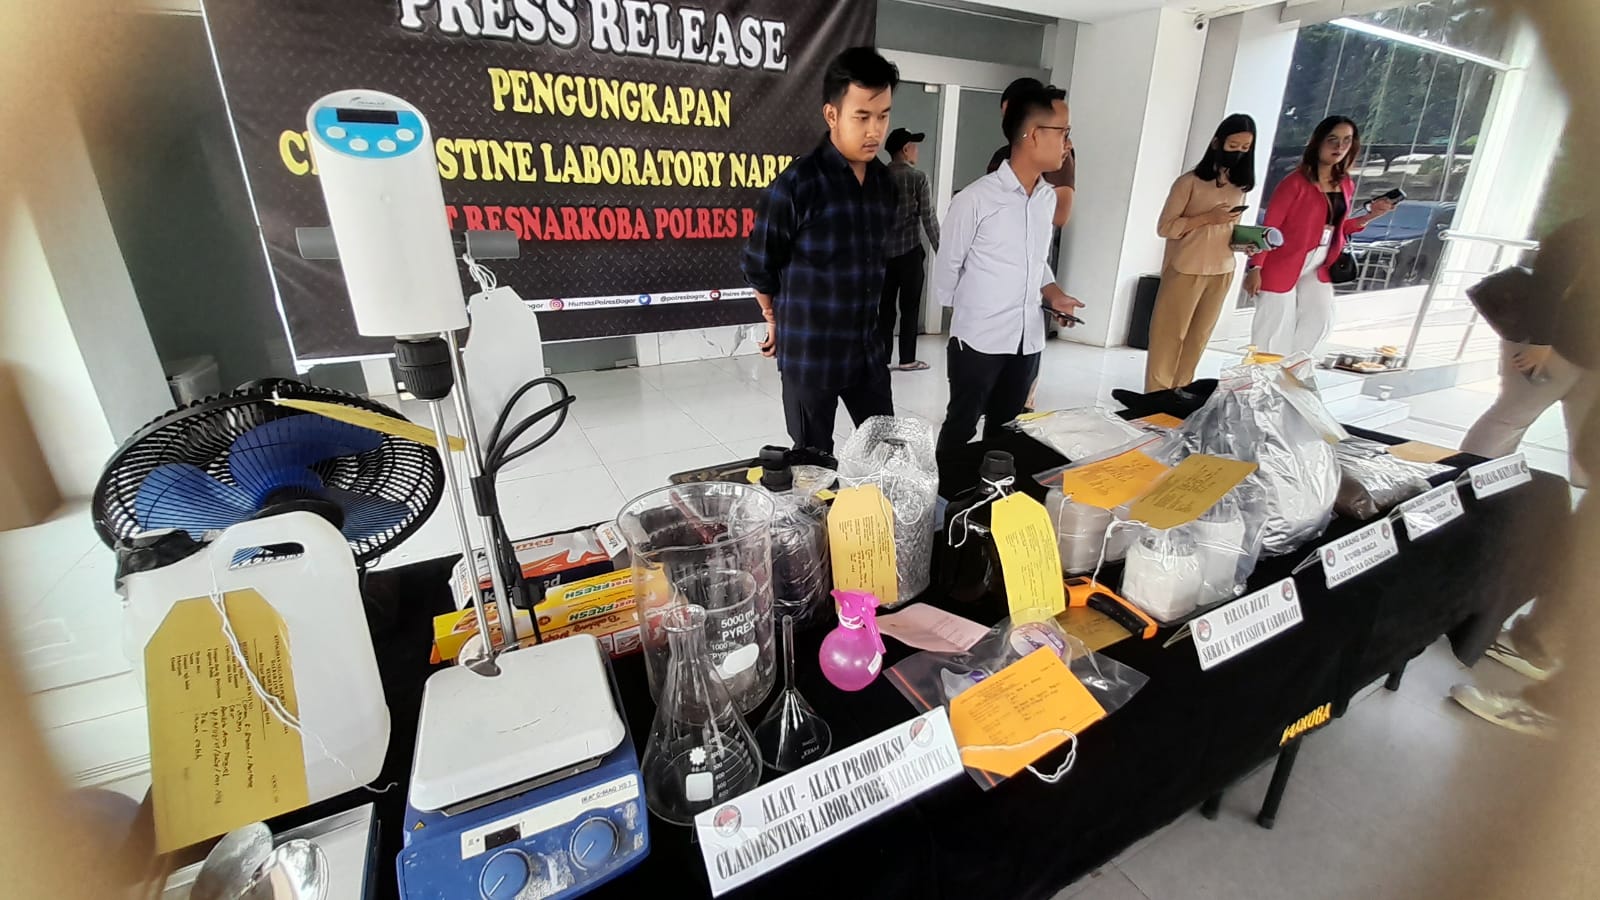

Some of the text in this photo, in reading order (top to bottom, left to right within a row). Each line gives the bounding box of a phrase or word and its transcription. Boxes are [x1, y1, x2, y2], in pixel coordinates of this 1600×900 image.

[400, 0, 789, 70] PRESS RELEASE
[487, 67, 732, 128] PENGUNGKAPAN
[540, 142, 725, 188] LABORATORY
[463, 205, 650, 241] RESNARKOBA
[654, 207, 738, 240] POLRES
[721, 613, 744, 629] 5000
[722, 621, 756, 641] PYREX
[1201, 637, 1231, 663] SERBUK
[760, 784, 798, 825] ALAT
[808, 765, 841, 802] ALAT
[842, 735, 906, 785] PRODUKSI
[716, 744, 956, 880] CLANDESTINE LABORATORY NARKOTIKA
